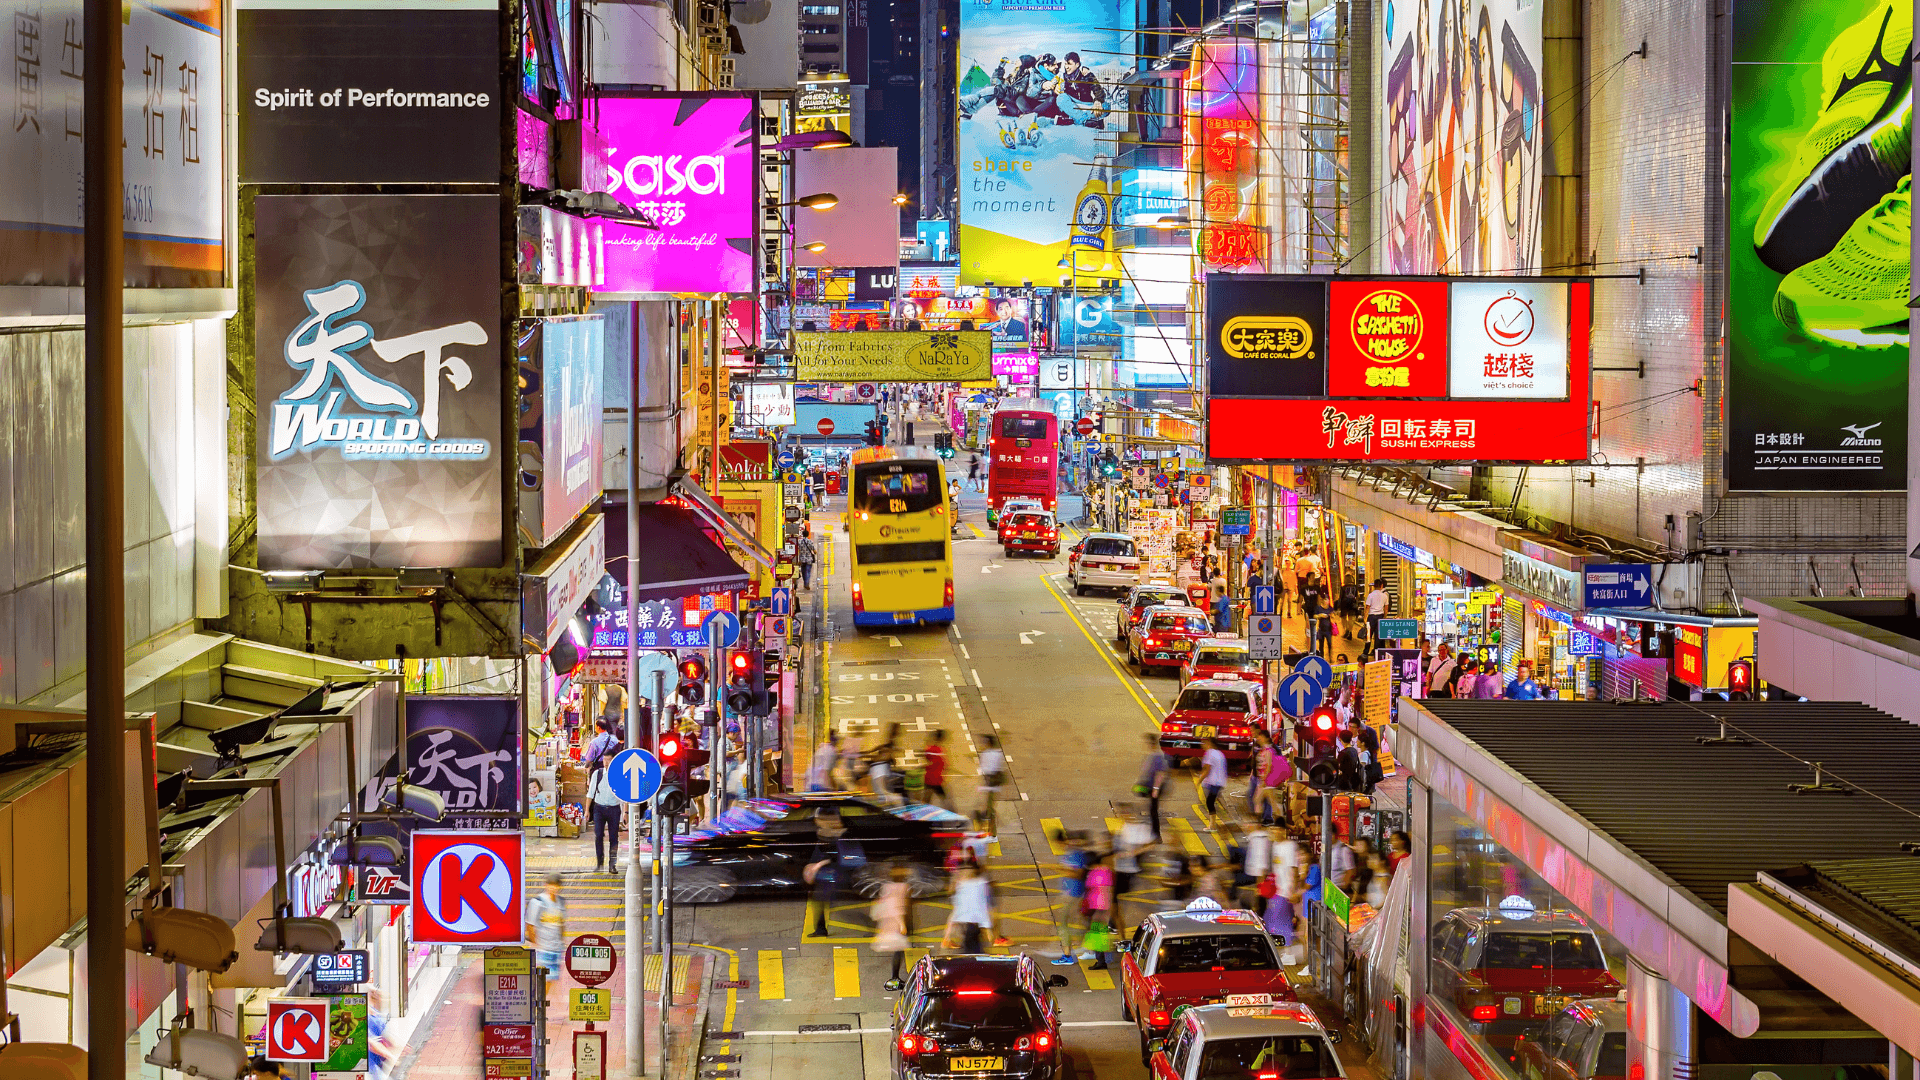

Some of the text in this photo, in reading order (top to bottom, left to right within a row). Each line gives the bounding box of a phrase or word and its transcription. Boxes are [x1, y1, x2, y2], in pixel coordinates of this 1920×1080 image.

[255, 88, 490, 111] Spirit of Performance
[972, 157, 1033, 172] share
[973, 177, 1006, 192] the
[972, 197, 1056, 213] moment
[605, 233, 718, 252] making life beautiful
[1072, 237, 1103, 247] BLUE GIRL
[870, 274, 896, 289] LU
[1370, 294, 1401, 313] THE
[816, 339, 846, 353] from
[848, 340, 893, 352] Fabrics
[1367, 337, 1409, 357] HOUSE
[281, 280, 489, 441] 天下
[810, 353, 830, 368] for
[830, 354, 857, 367] Your
[859, 354, 893, 366] Needs
[918, 350, 970, 366] NaRaYa
[1244, 351, 1260, 359] CAFÉ
[1483, 352, 1535, 379] 越棧
[816, 371, 873, 379] www.naraya.com
[270, 390, 421, 456] WORLD
[1380, 418, 1476, 439] 回転寿司
[1380, 439, 1476, 449] SUSHI EXPRESS
[1755, 432, 1805, 446] 日本設計
[344, 442, 486, 455] SPORTING GOODS
[1755, 456, 1881, 464] JAPAN ENGINEERED
[1269, 637, 1275, 645] 7
[1269, 649, 1279, 657] 12
[838, 672, 921, 682] BUS
[829, 693, 940, 705] STOP
[416, 729, 513, 808] 天下
[575, 946, 608, 958] 904 905
[499, 976, 517, 989] E21A
[582, 994, 596, 1004] 905
[1230, 995, 1269, 1006] TAXI
